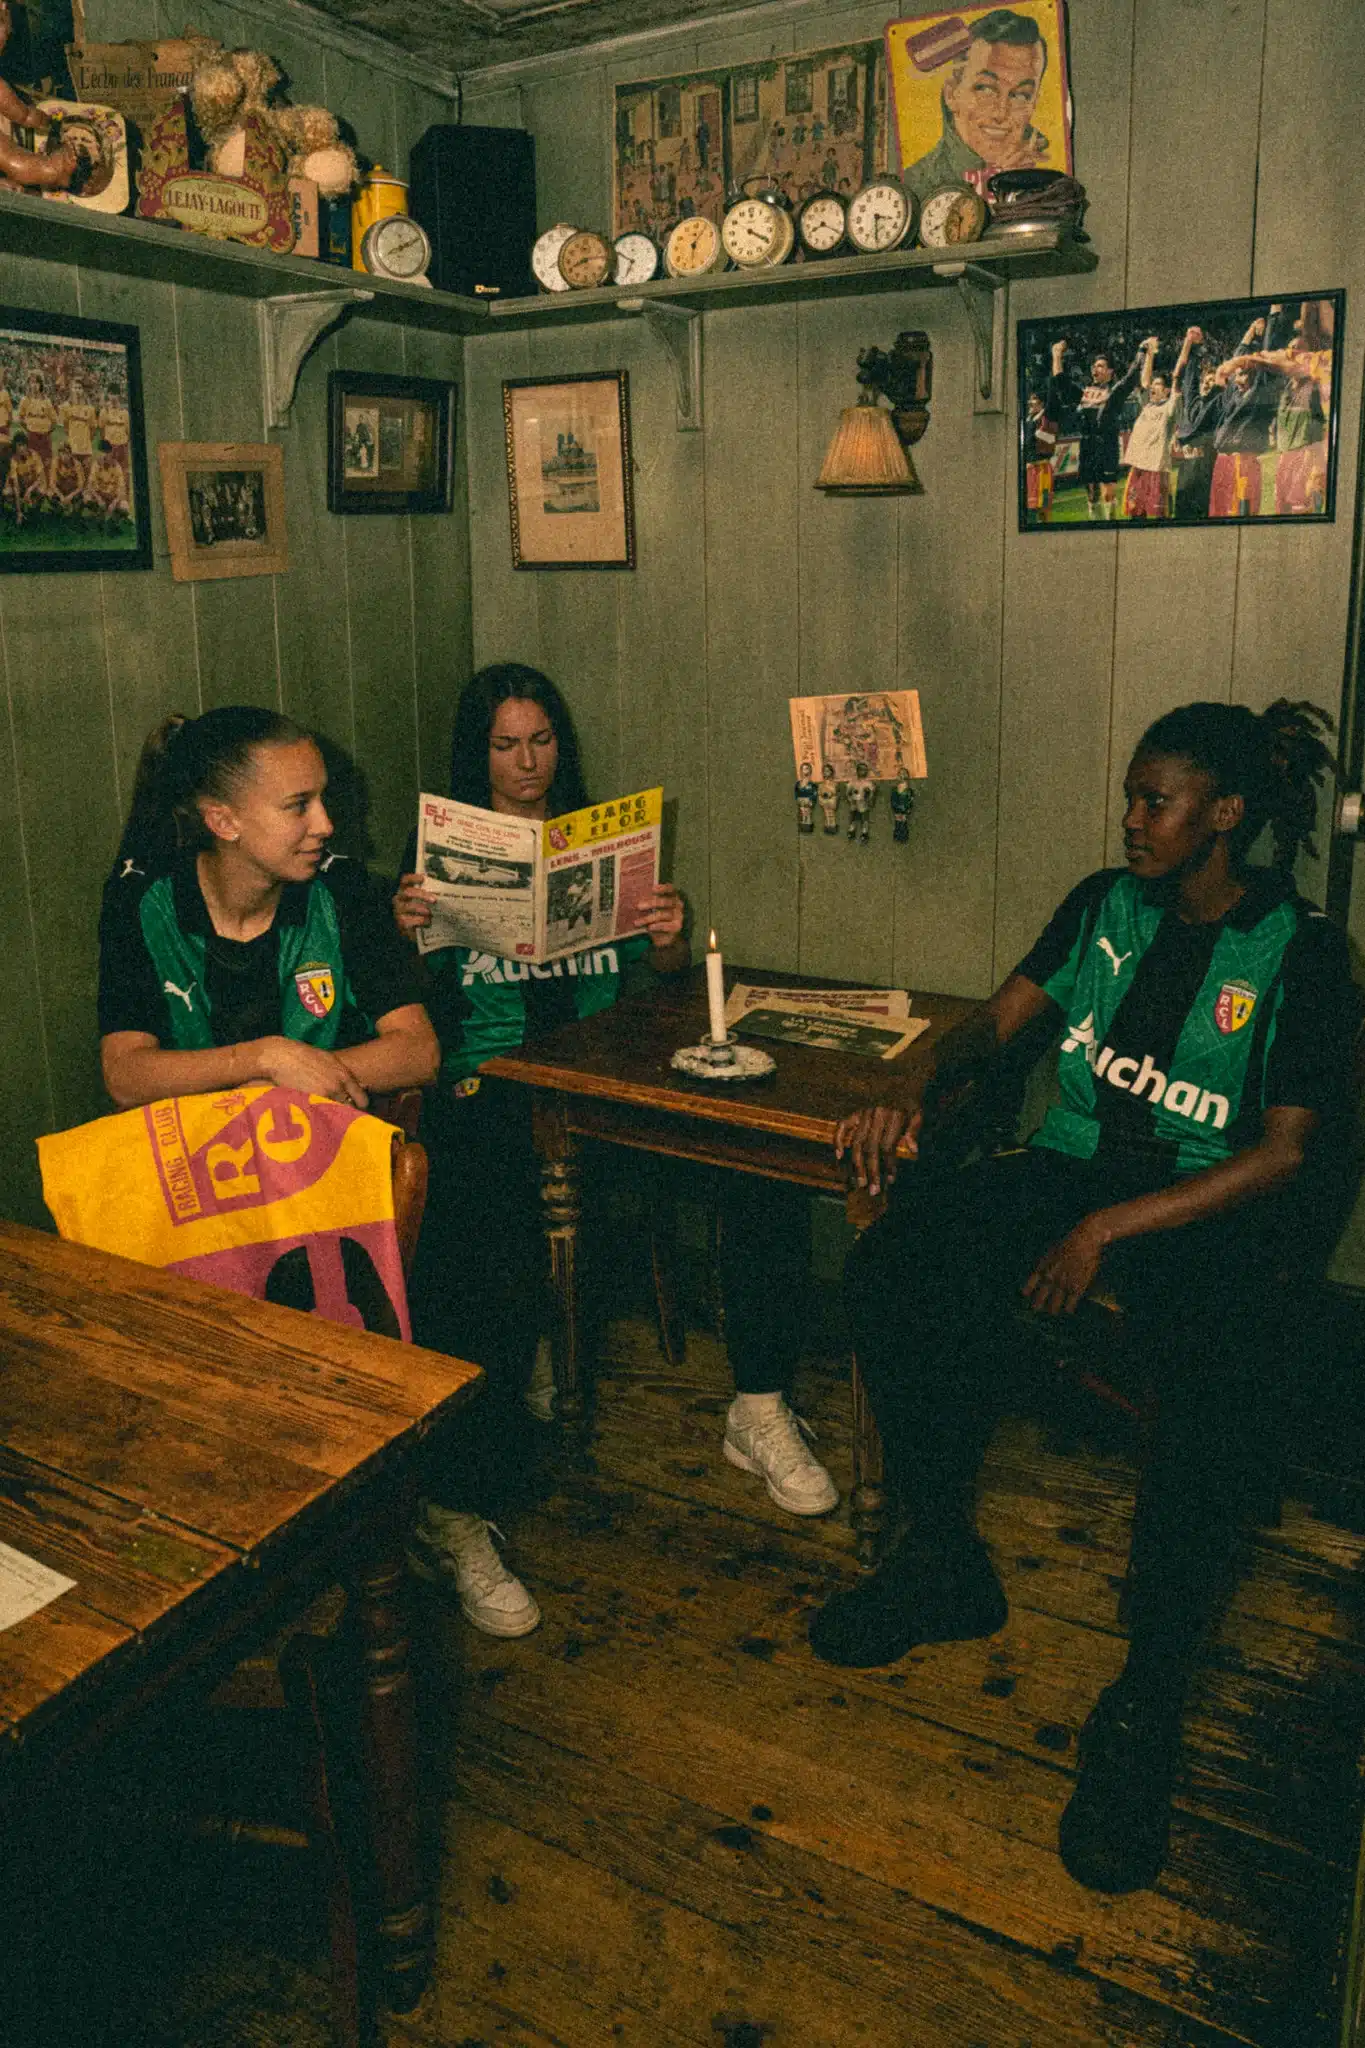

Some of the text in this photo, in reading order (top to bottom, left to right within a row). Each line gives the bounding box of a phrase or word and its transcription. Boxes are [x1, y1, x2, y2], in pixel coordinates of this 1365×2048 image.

[591, 795, 646, 822] SANG
[619, 809, 646, 828] OR
[550, 852, 579, 869] LENS
[591, 831, 652, 857] MULHOUSE
[299, 983, 324, 1014] RCL
[1219, 994, 1230, 1029] RCL
[154, 1107, 197, 1217] RACING CLUB
